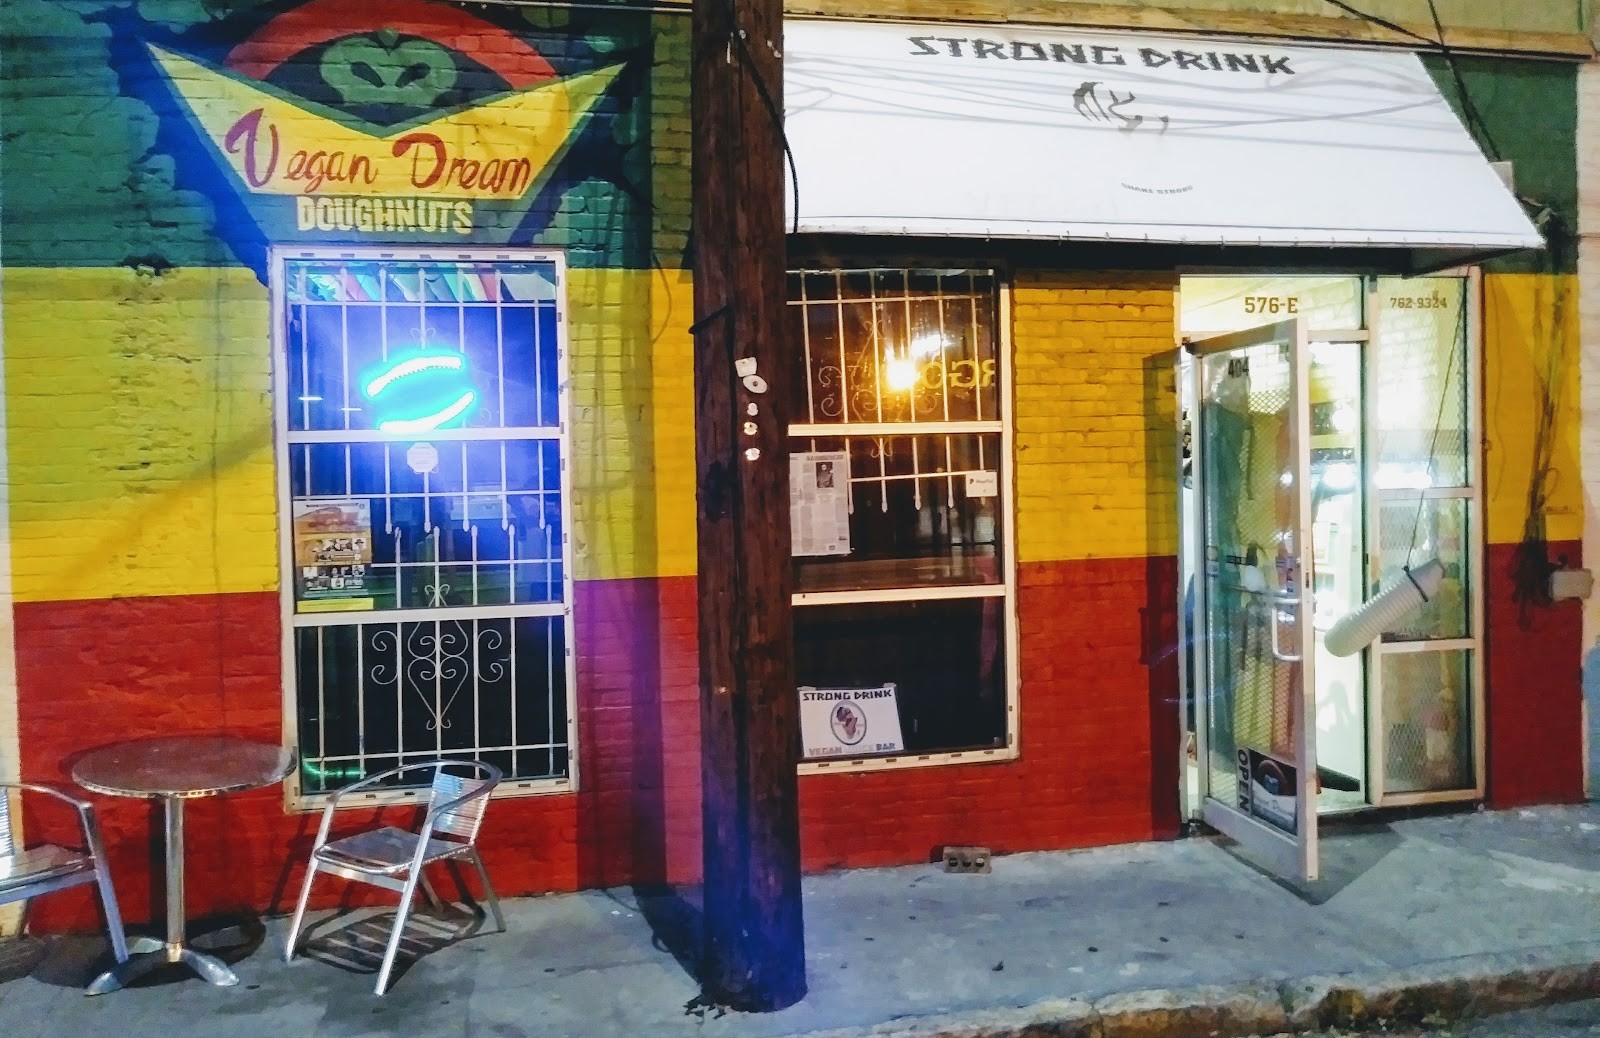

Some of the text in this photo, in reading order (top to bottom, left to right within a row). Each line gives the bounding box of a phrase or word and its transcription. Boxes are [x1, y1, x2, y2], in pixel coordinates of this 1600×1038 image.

[906, 35, 1296, 75] STRONG DRINK
[224, 108, 531, 196] Vegan Dream
[296, 196, 474, 236] DOUGHNUTS
[1244, 296, 1298, 314] 576-E
[803, 689, 892, 701] STRONG DRINK
[808, 747, 842, 756] VEGAN
[876, 743, 896, 752] BAR
[1238, 749, 1250, 812] OPEN
